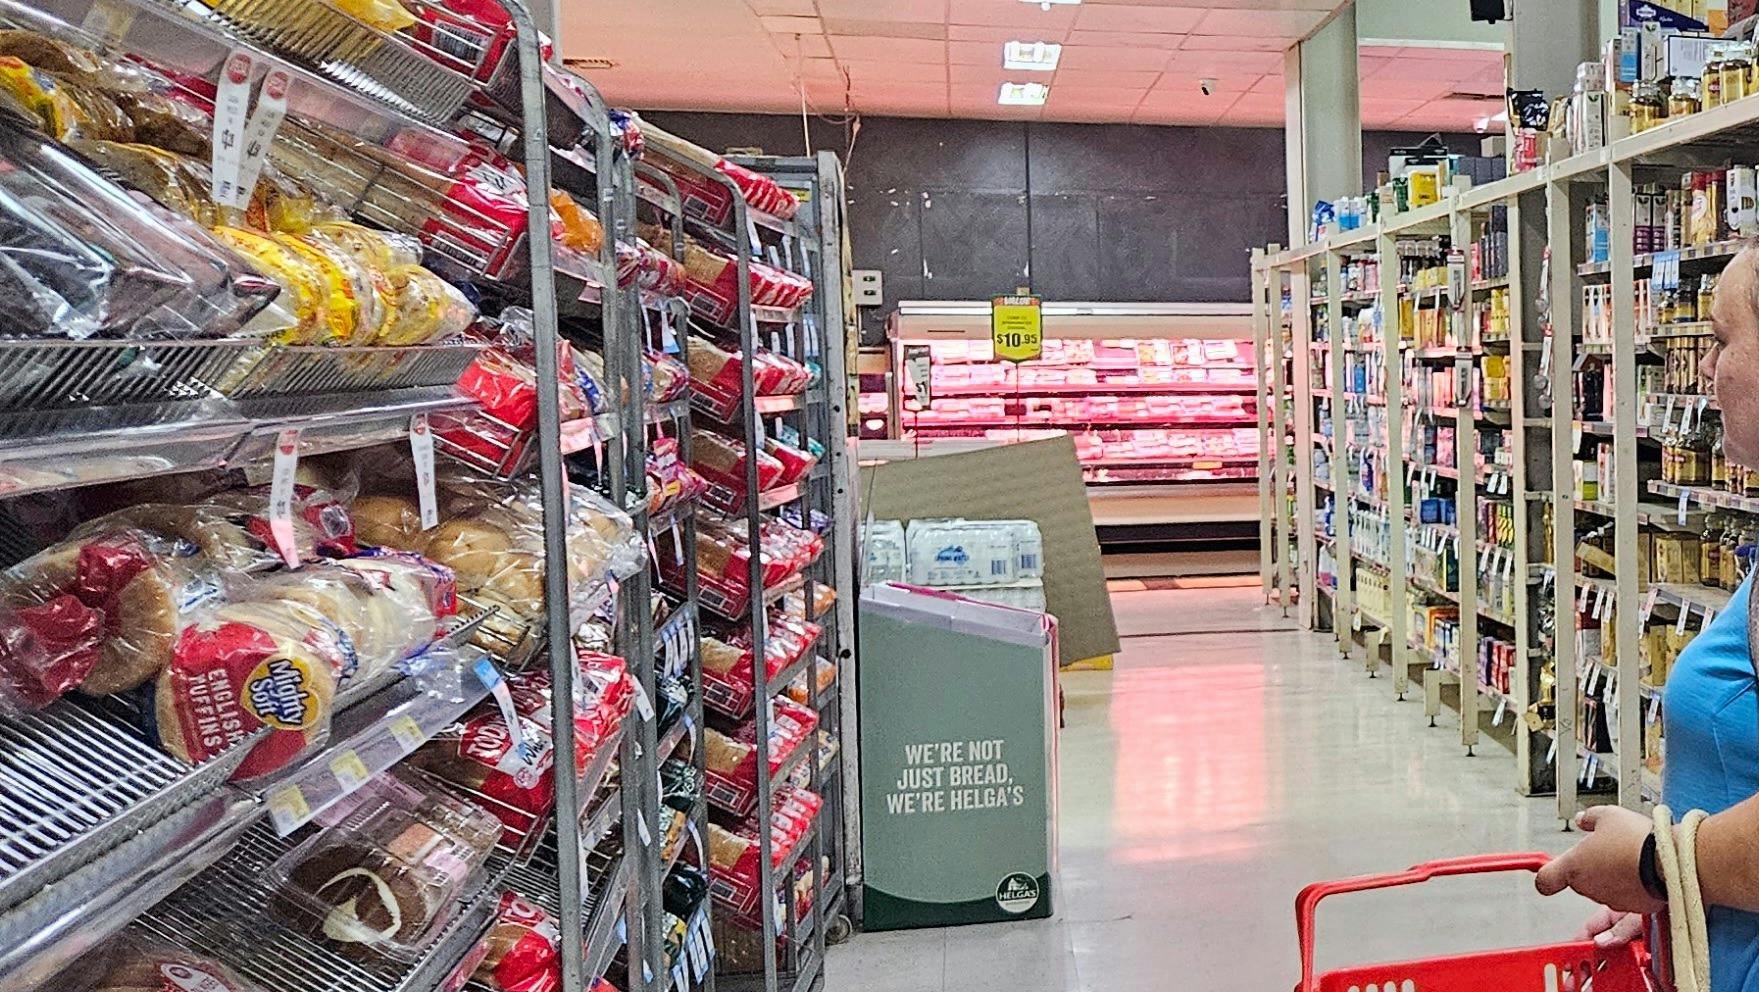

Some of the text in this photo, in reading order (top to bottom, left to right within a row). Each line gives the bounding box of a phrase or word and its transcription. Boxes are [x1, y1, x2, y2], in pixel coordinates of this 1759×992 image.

[996, 332, 1038, 348] $10.95
[208, 668, 244, 745] ENGLISH
[250, 677, 278, 719] Soft
[269, 658, 307, 725] Mighty
[188, 673, 224, 748] MUFFINS
[905, 739, 1005, 766] WE'RE NOT
[897, 763, 1014, 790] JUST BREAD,
[886, 785, 1025, 815] WE'RE HELGA'S
